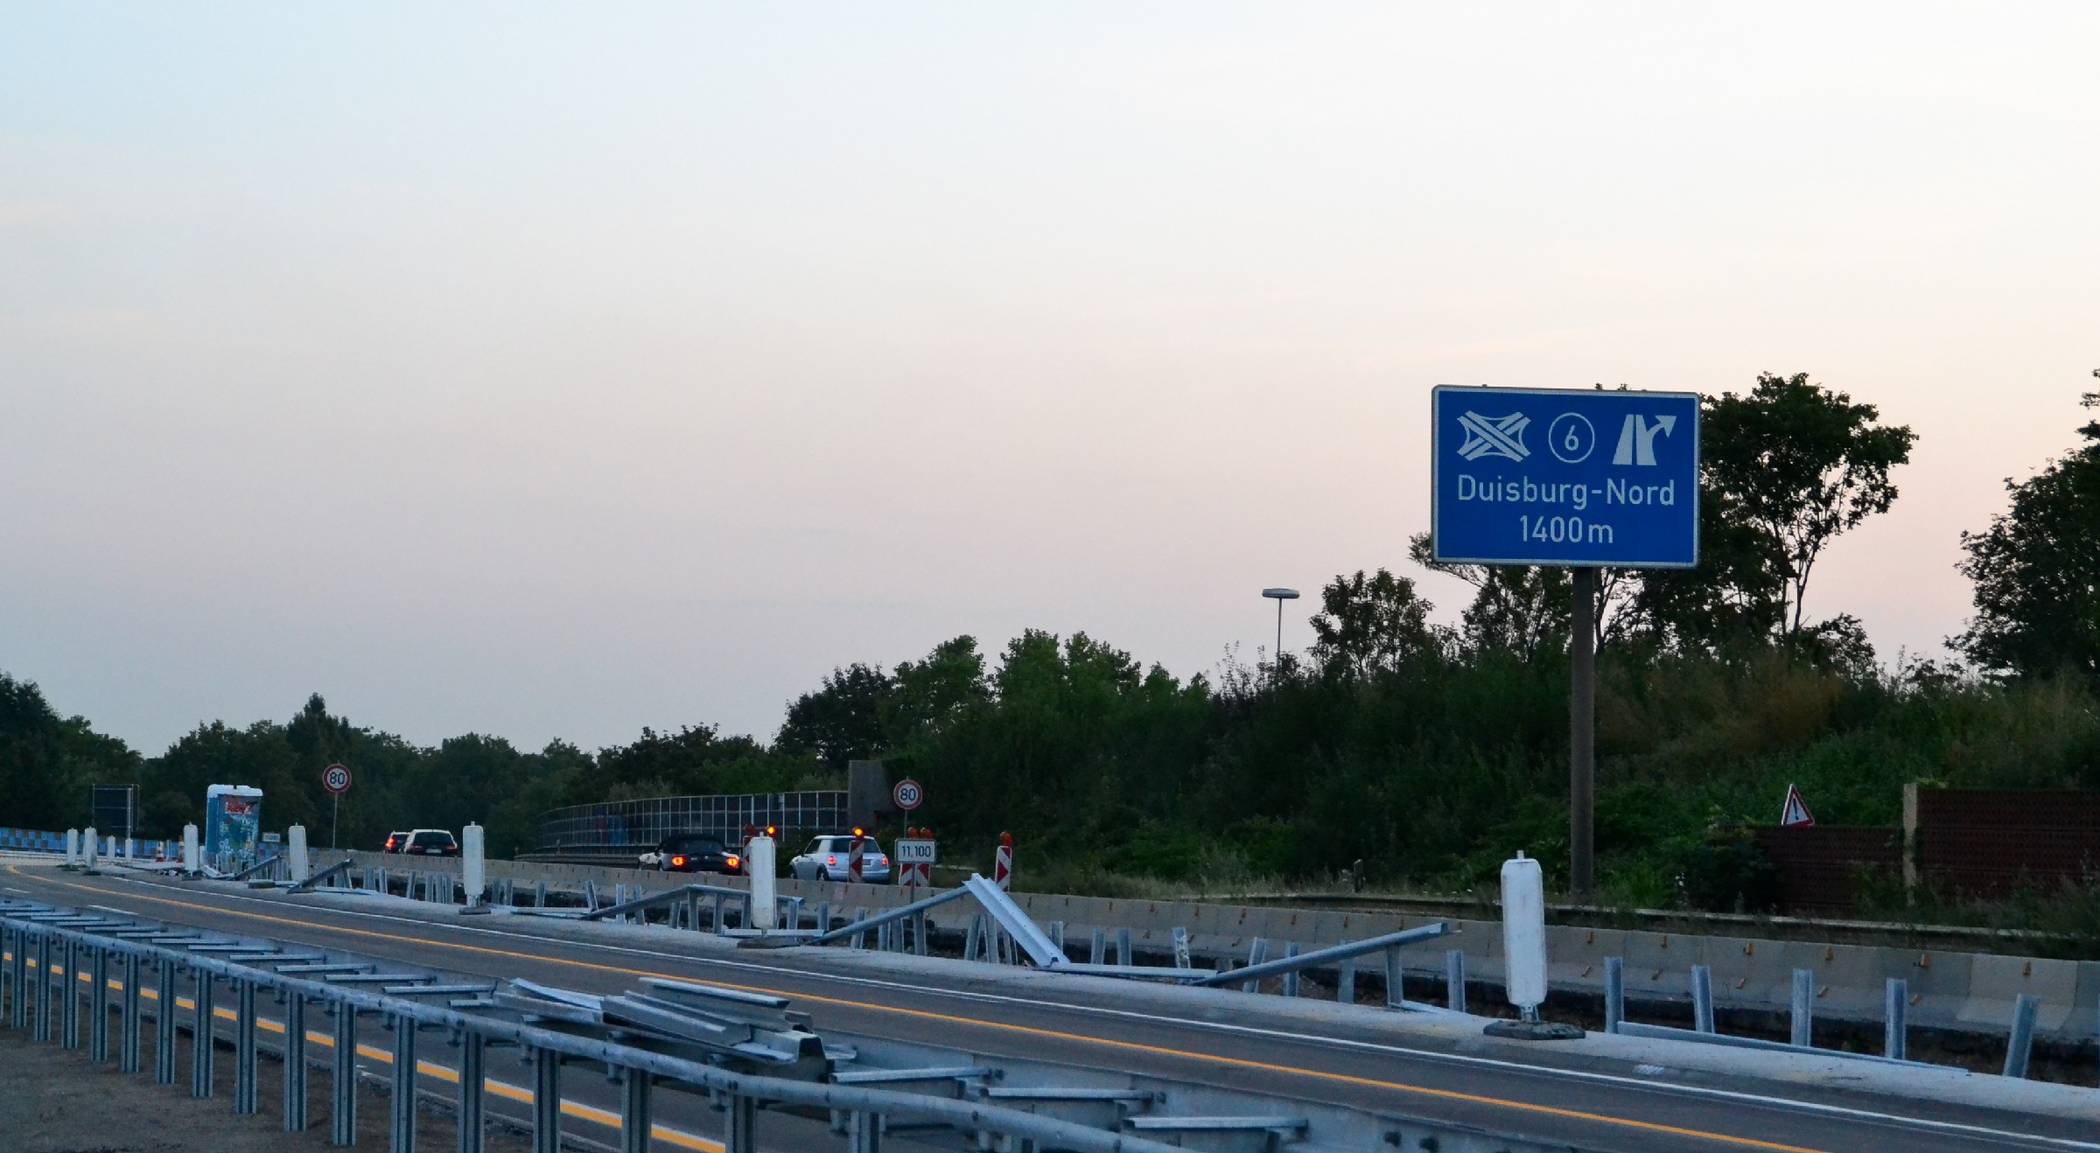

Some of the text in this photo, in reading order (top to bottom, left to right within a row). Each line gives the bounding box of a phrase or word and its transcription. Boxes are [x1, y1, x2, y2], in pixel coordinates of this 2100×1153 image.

[1564, 425, 1579, 451] 6
[1457, 474, 1675, 510] Duisburg-Nord
[330, 772, 345, 784] 80
[900, 789, 916, 802] 80
